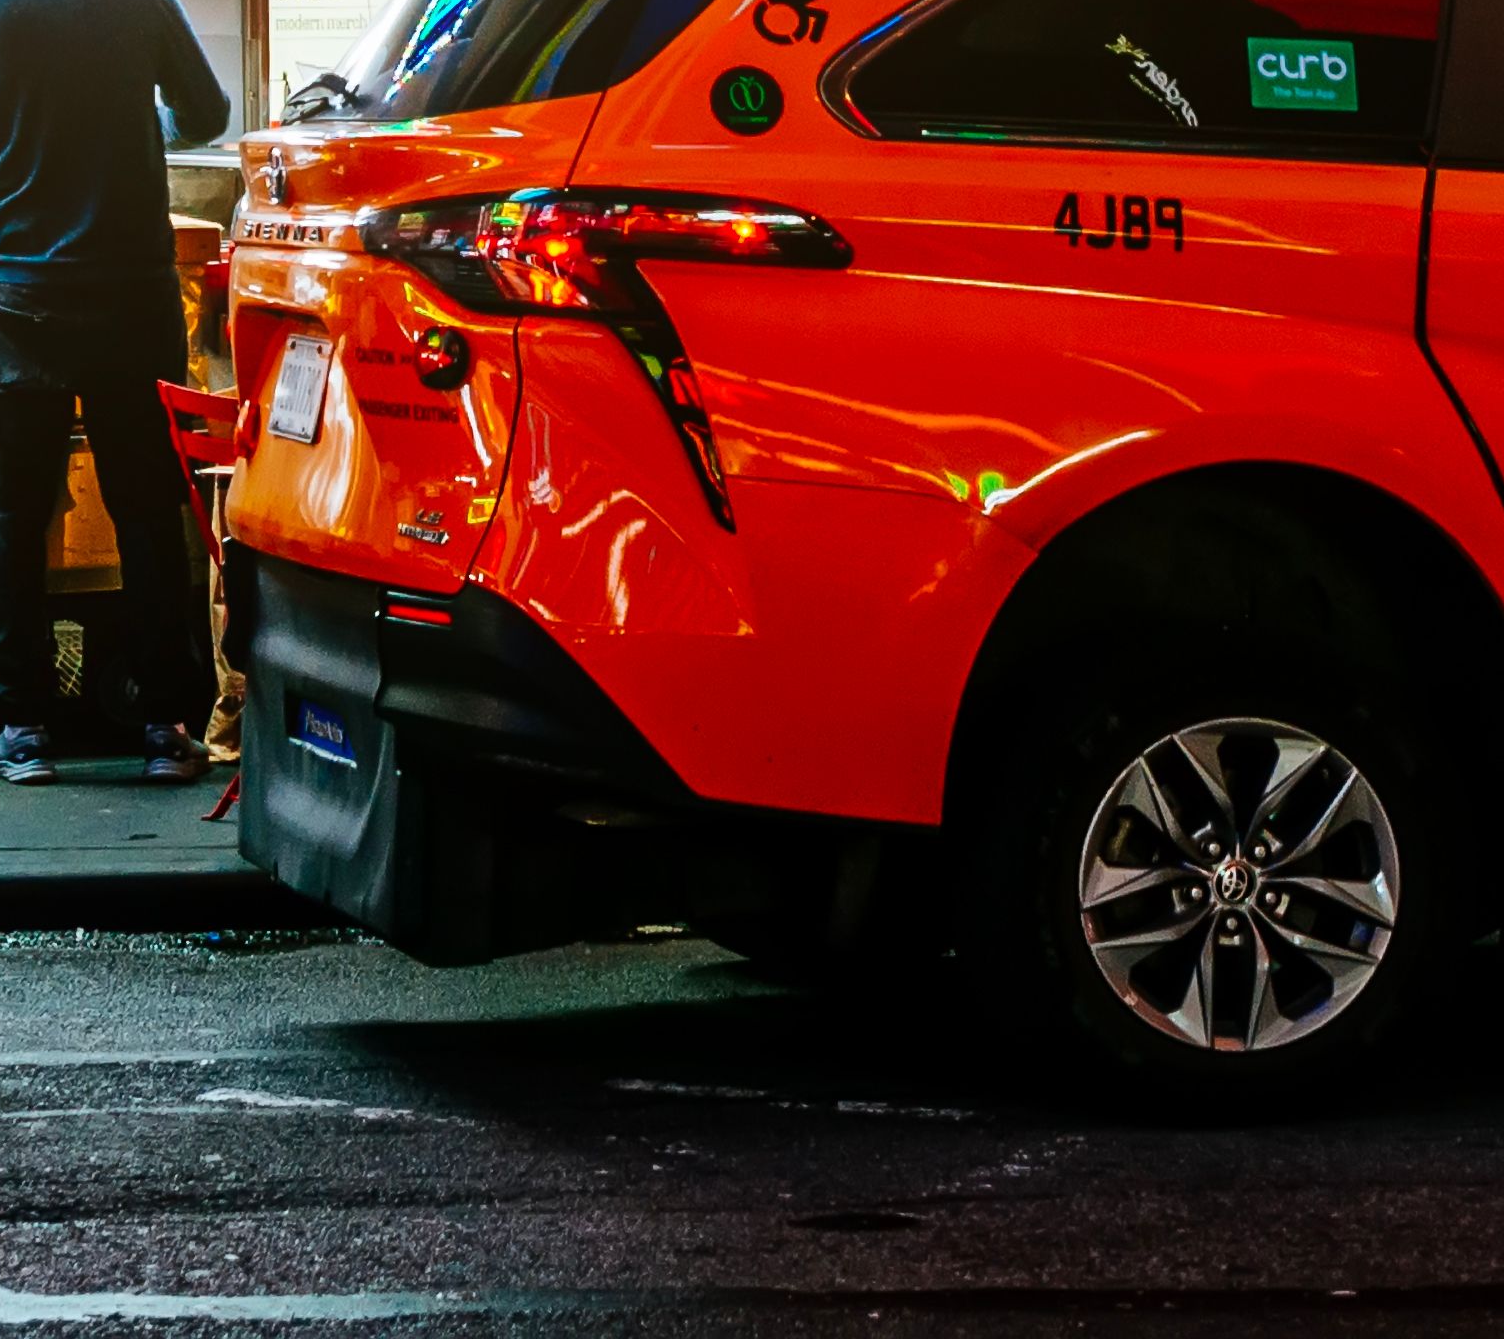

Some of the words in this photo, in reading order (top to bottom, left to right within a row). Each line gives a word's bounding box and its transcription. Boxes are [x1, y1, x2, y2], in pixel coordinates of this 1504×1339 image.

[275, 14, 323, 32] modern
[1256, 50, 1348, 82] curb
[243, 219, 324, 243] SIENNA
[356, 346, 395, 366] CAUTION
[413, 404, 460, 425] EXITING
